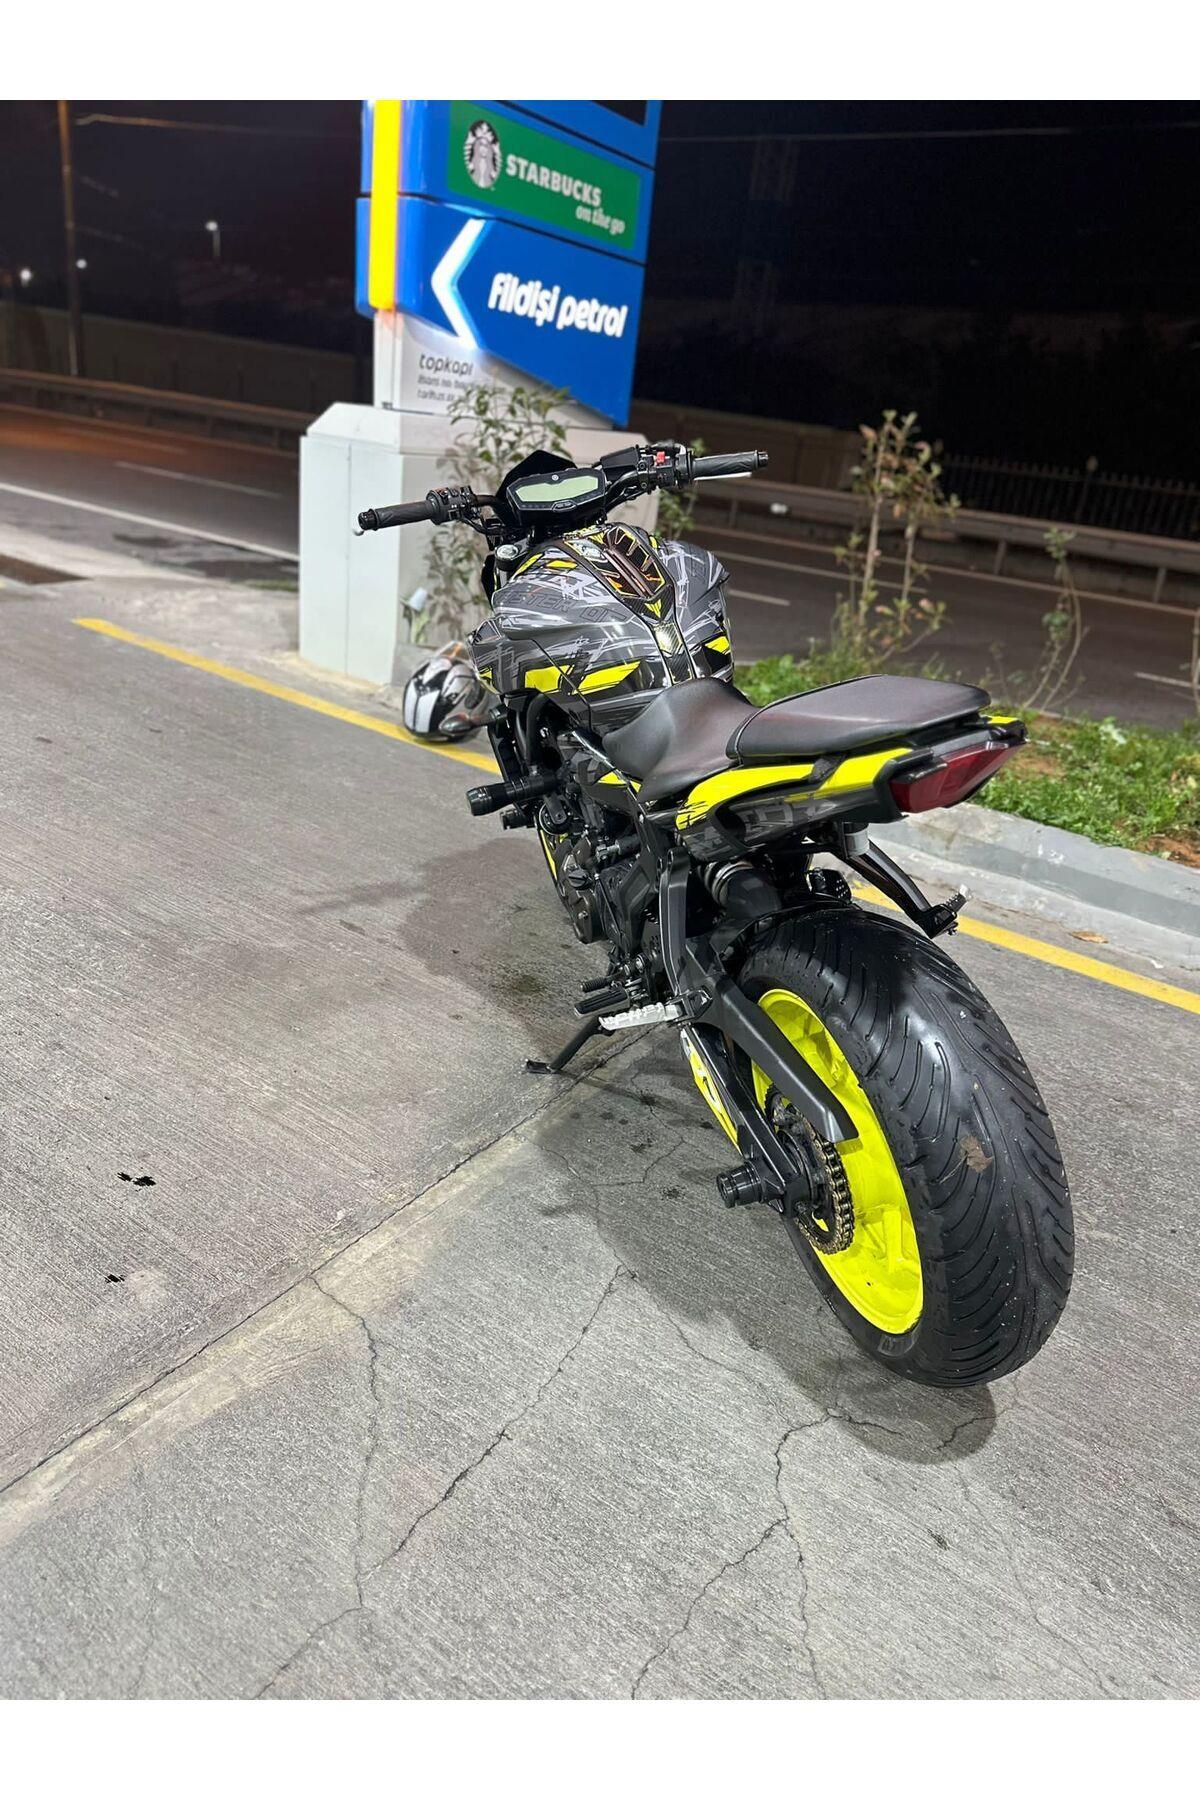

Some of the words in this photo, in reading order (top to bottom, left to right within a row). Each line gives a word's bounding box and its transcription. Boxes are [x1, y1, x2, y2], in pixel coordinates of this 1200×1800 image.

[506, 153, 602, 207] STARBUCKS
[575, 205, 592, 222] on
[591, 207, 611, 229] the
[609, 218, 626, 235] go
[556, 295, 628, 338] petrol
